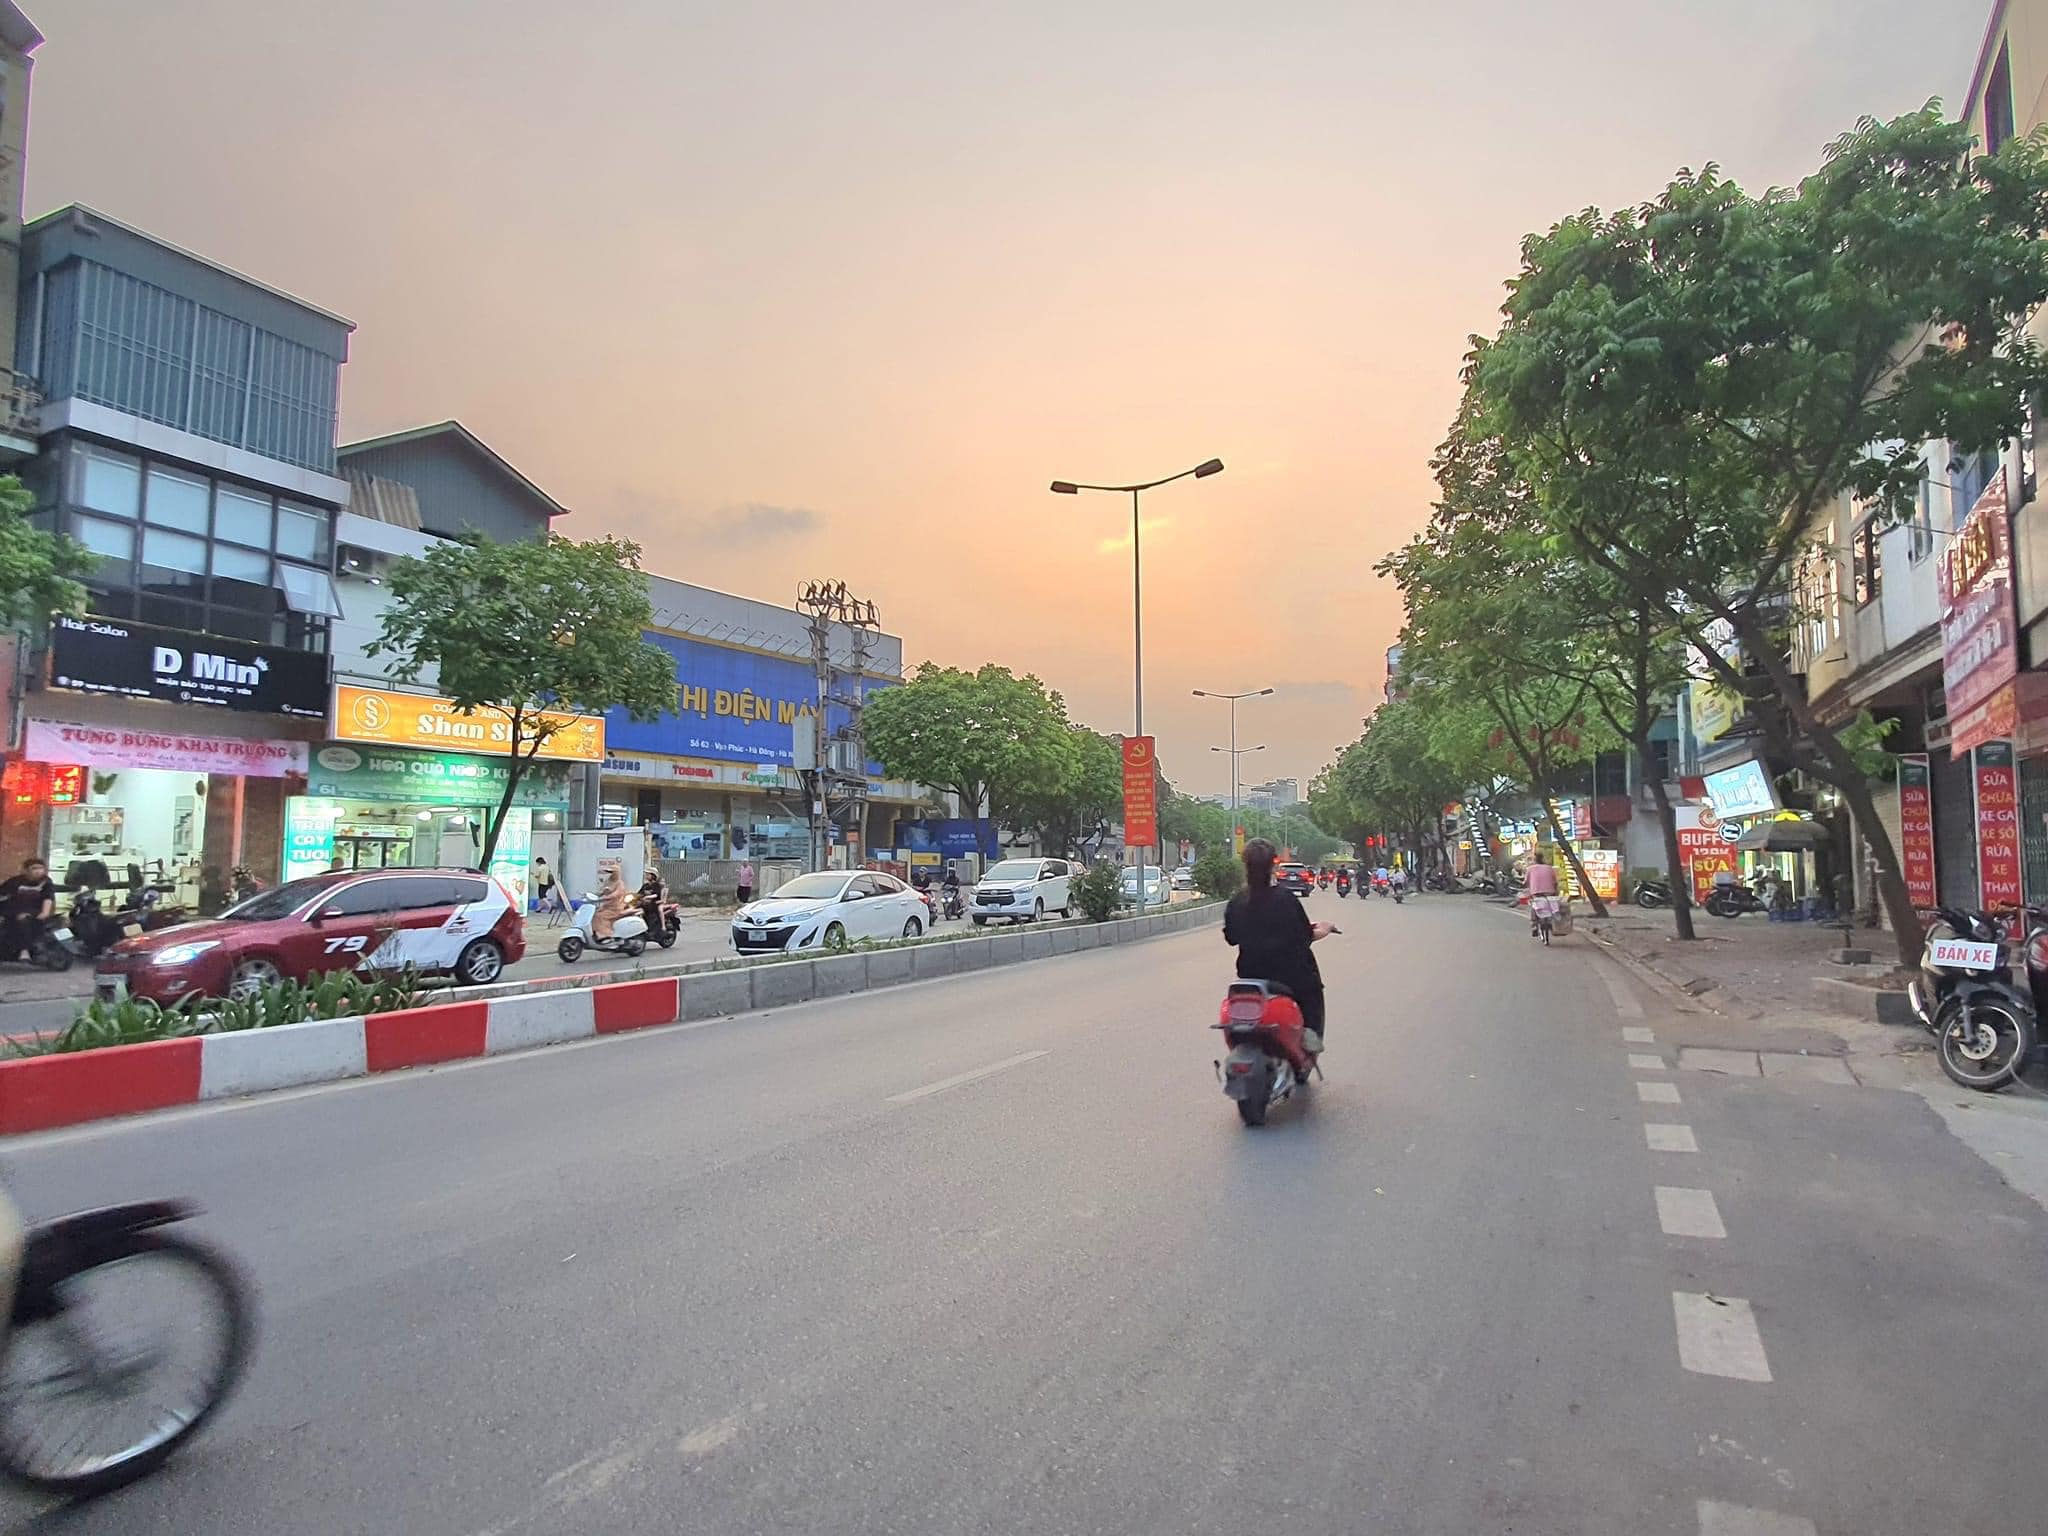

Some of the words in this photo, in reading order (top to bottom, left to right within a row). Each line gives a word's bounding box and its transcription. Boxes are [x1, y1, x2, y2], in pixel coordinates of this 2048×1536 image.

[62, 617, 88, 631] Hair
[90, 622, 128, 637] Salon
[153, 646, 183, 674] D
[192, 652, 260, 685] Min
[674, 683, 708, 719] HỊ
[714, 688, 771, 726] ĐIỆN
[417, 713, 485, 739] Shan
[177, 739, 219, 752] KHAI
[369, 758, 406, 772] HOA
[672, 765, 714, 778] TOSHIBA
[319, 784, 337, 795] 61
[1980, 811, 1995, 821] XE
[1997, 811, 2015, 821] GA
[1982, 828, 1995, 839] XE
[1992, 863, 2008, 875] XE
[1907, 881, 1931, 891] THAY
[1984, 881, 2017, 893] THAY
[325, 935, 367, 954] 79
[1937, 944, 1968, 961] BÁN
[1972, 949, 1992, 963] XE
